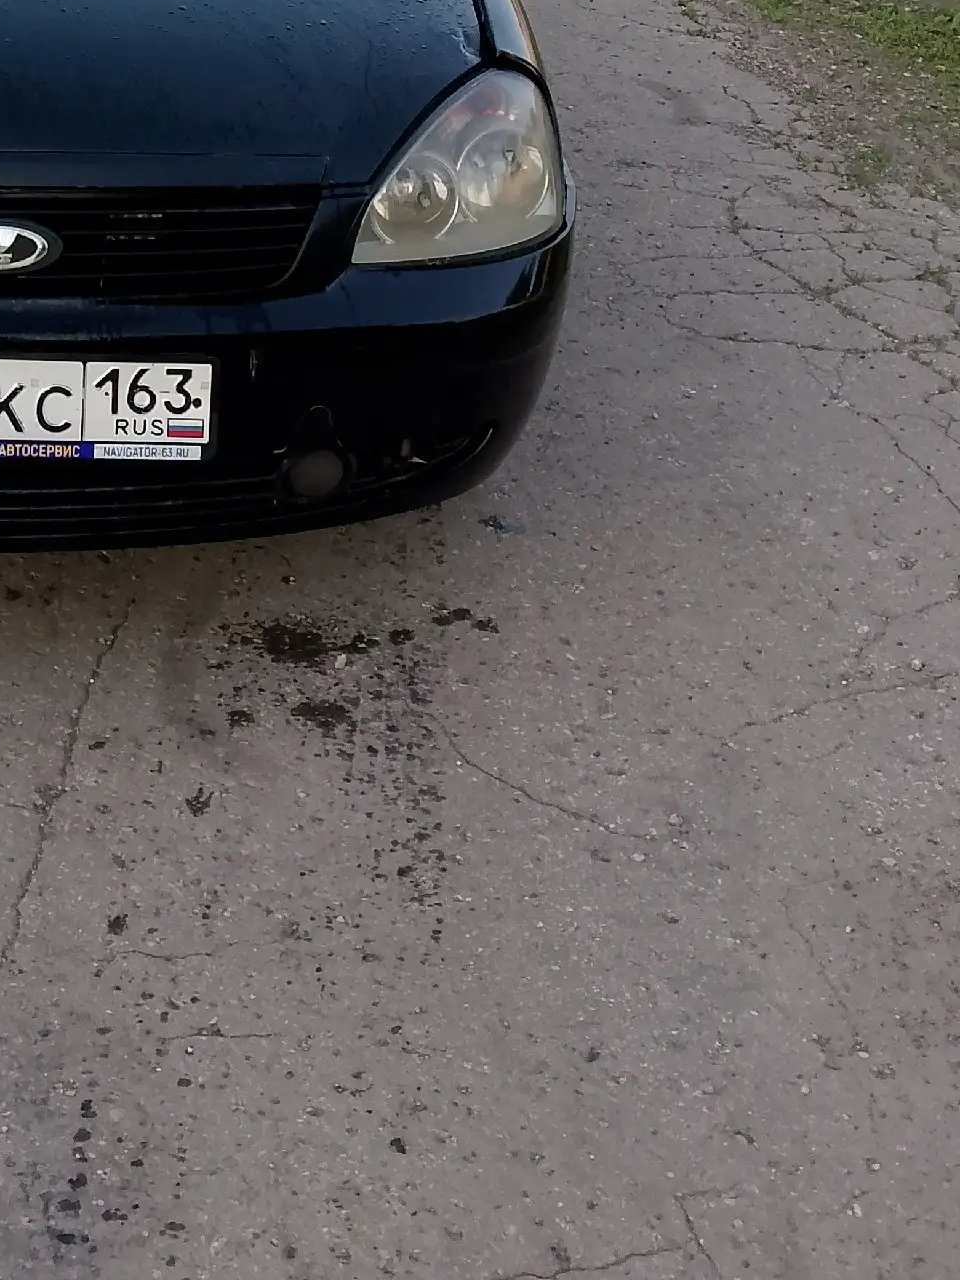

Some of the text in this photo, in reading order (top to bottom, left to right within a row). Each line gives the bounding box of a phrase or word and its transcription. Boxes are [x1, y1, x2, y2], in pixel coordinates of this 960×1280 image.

[94, 368, 193, 415] 163
[115, 419, 164, 435] RUS
[103, 446, 190, 458] NAVIGATOR-63.RU
